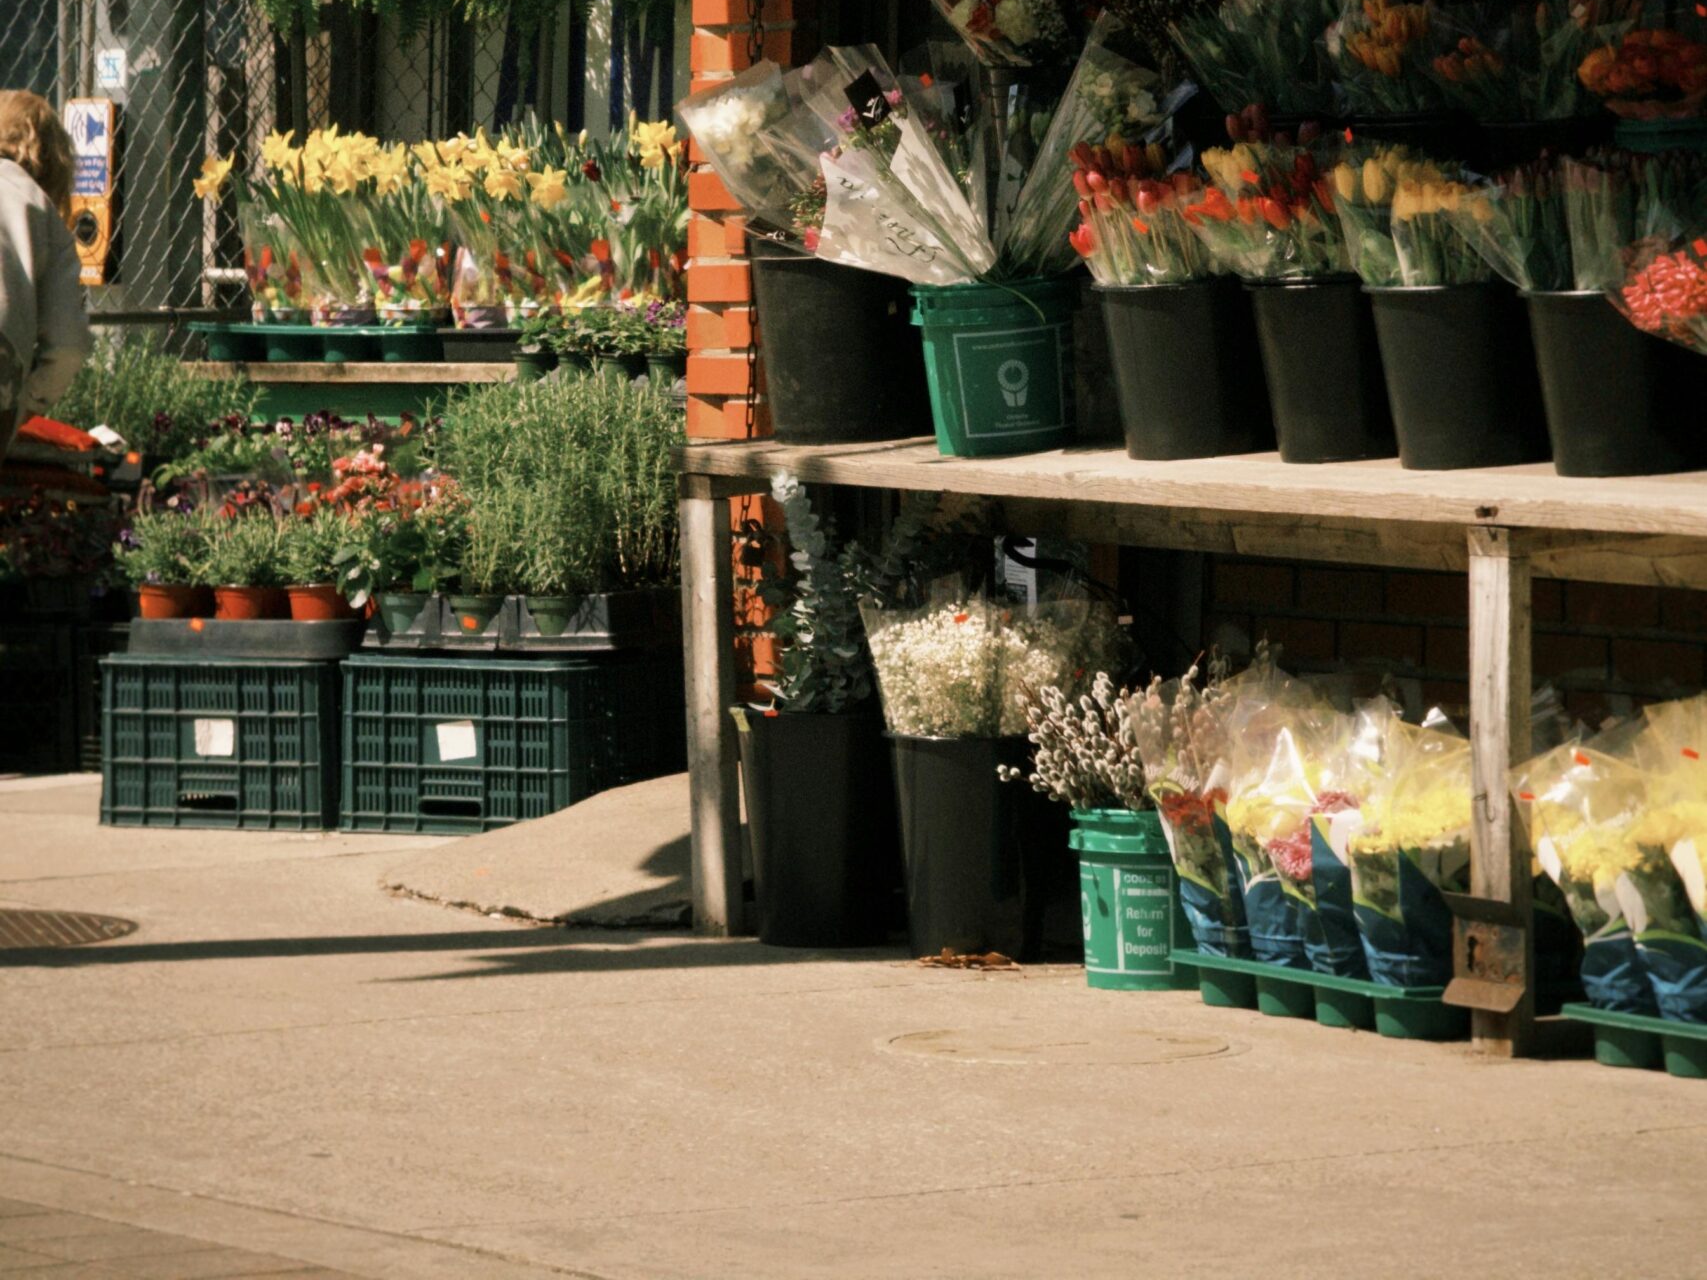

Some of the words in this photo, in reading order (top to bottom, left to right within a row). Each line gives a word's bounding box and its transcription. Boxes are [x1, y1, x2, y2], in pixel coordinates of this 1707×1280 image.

[1126, 907, 1163, 920] Return
[1137, 925, 1153, 937] for
[1125, 942, 1167, 957] Deposit
